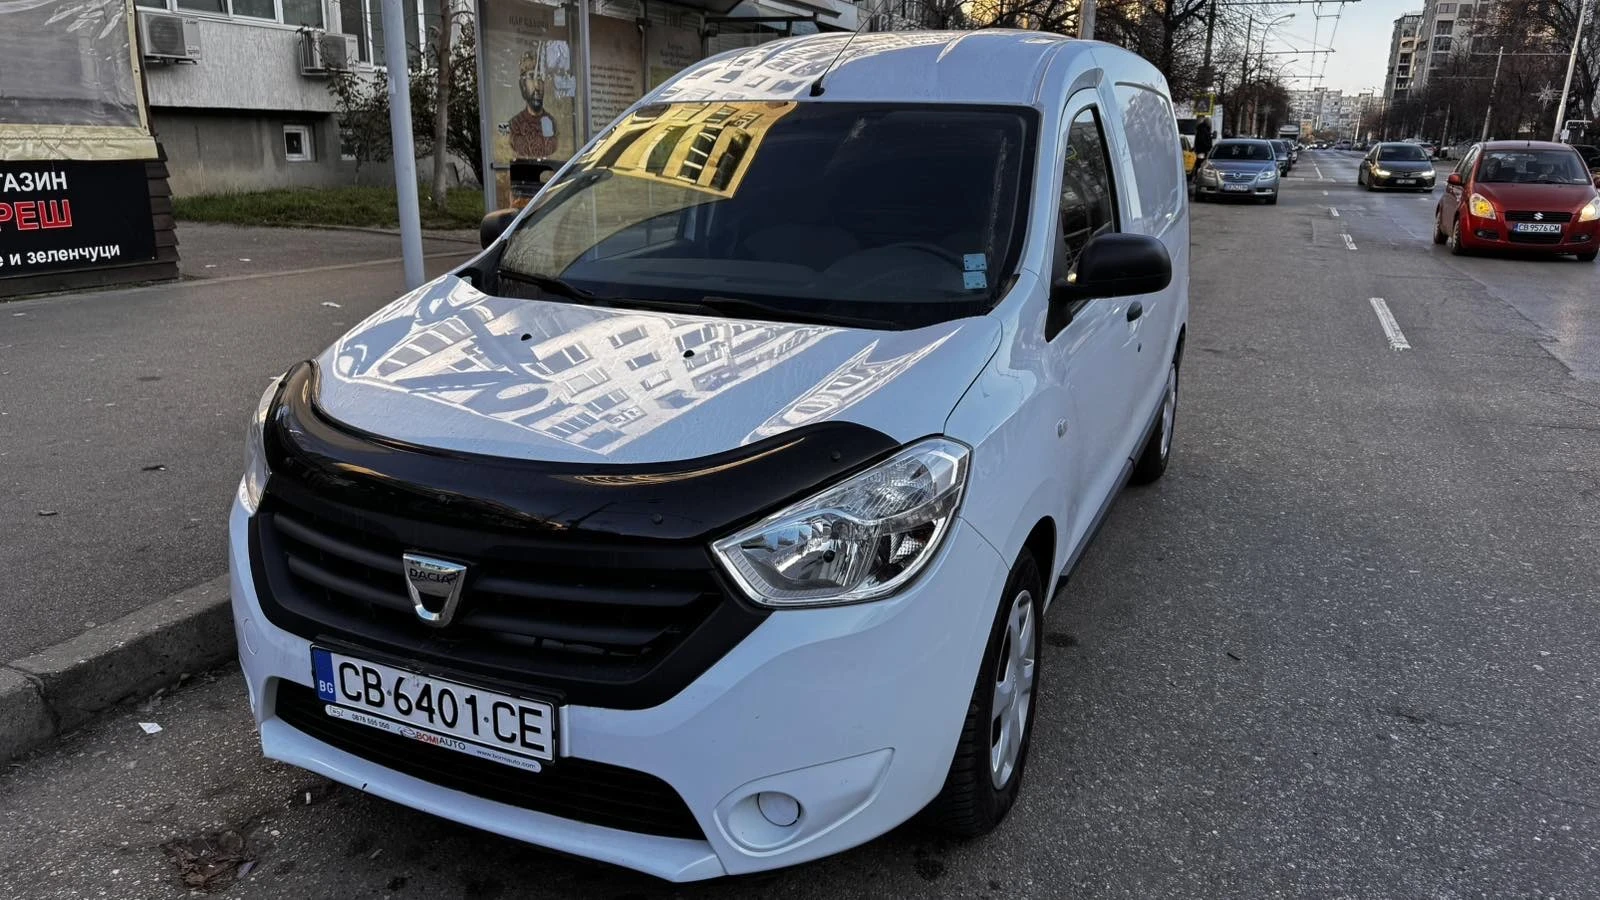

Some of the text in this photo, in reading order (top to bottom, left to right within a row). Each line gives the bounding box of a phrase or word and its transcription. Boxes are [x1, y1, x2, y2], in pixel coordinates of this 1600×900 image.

[0, 171, 68, 192] АЗИН
[10, 253, 22, 266] и
[27, 244, 120, 264] зеленчуци
[410, 568, 451, 584] DACIA
[319, 679, 334, 694] BG
[393, 676, 479, 736] 6401
[492, 701, 545, 752] CE
